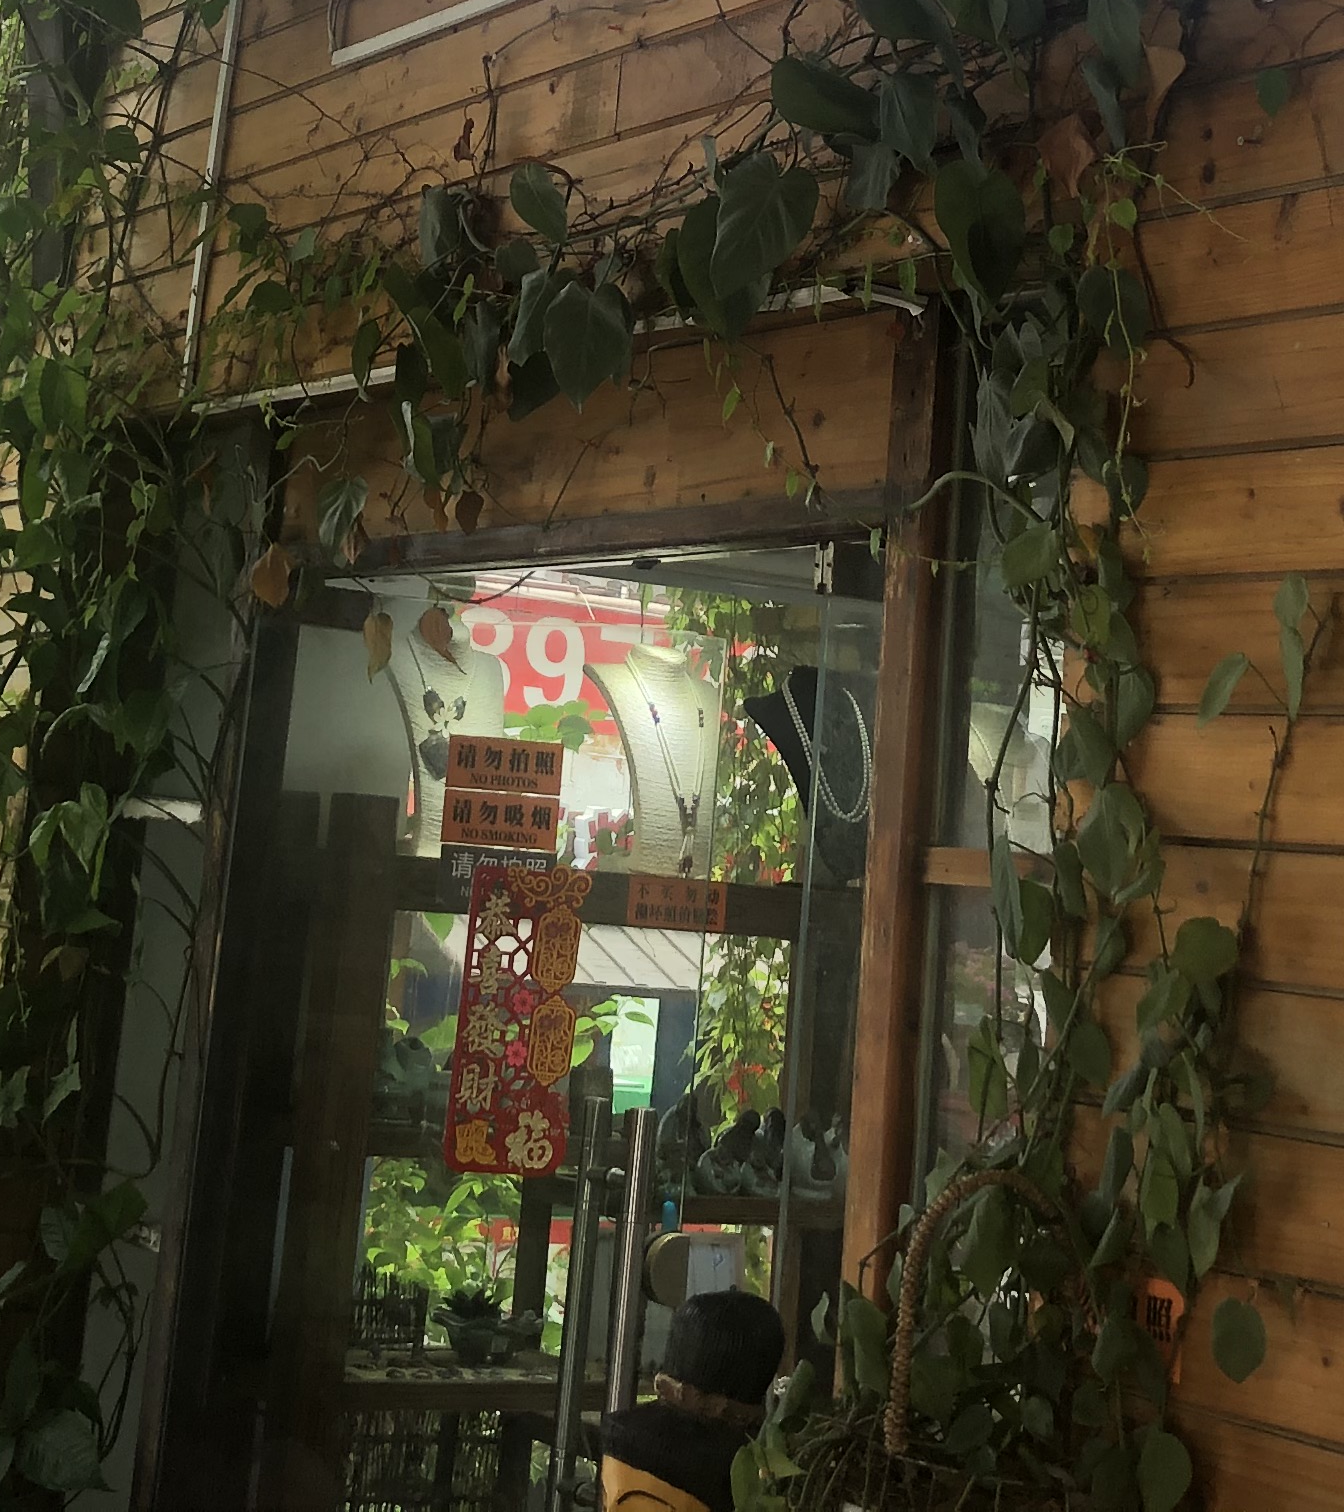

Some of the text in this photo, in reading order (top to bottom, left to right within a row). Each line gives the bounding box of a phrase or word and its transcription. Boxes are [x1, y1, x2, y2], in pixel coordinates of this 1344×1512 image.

[457, 743, 556, 776] 请勿拍照
[470, 772, 538, 788] NO PHOTOS
[452, 798, 552, 831] 请勿吸烟
[461, 827, 537, 845] NO SMOKING
[455, 888, 517, 1111] 恭喜發財
[505, 1108, 553, 1170] 福
